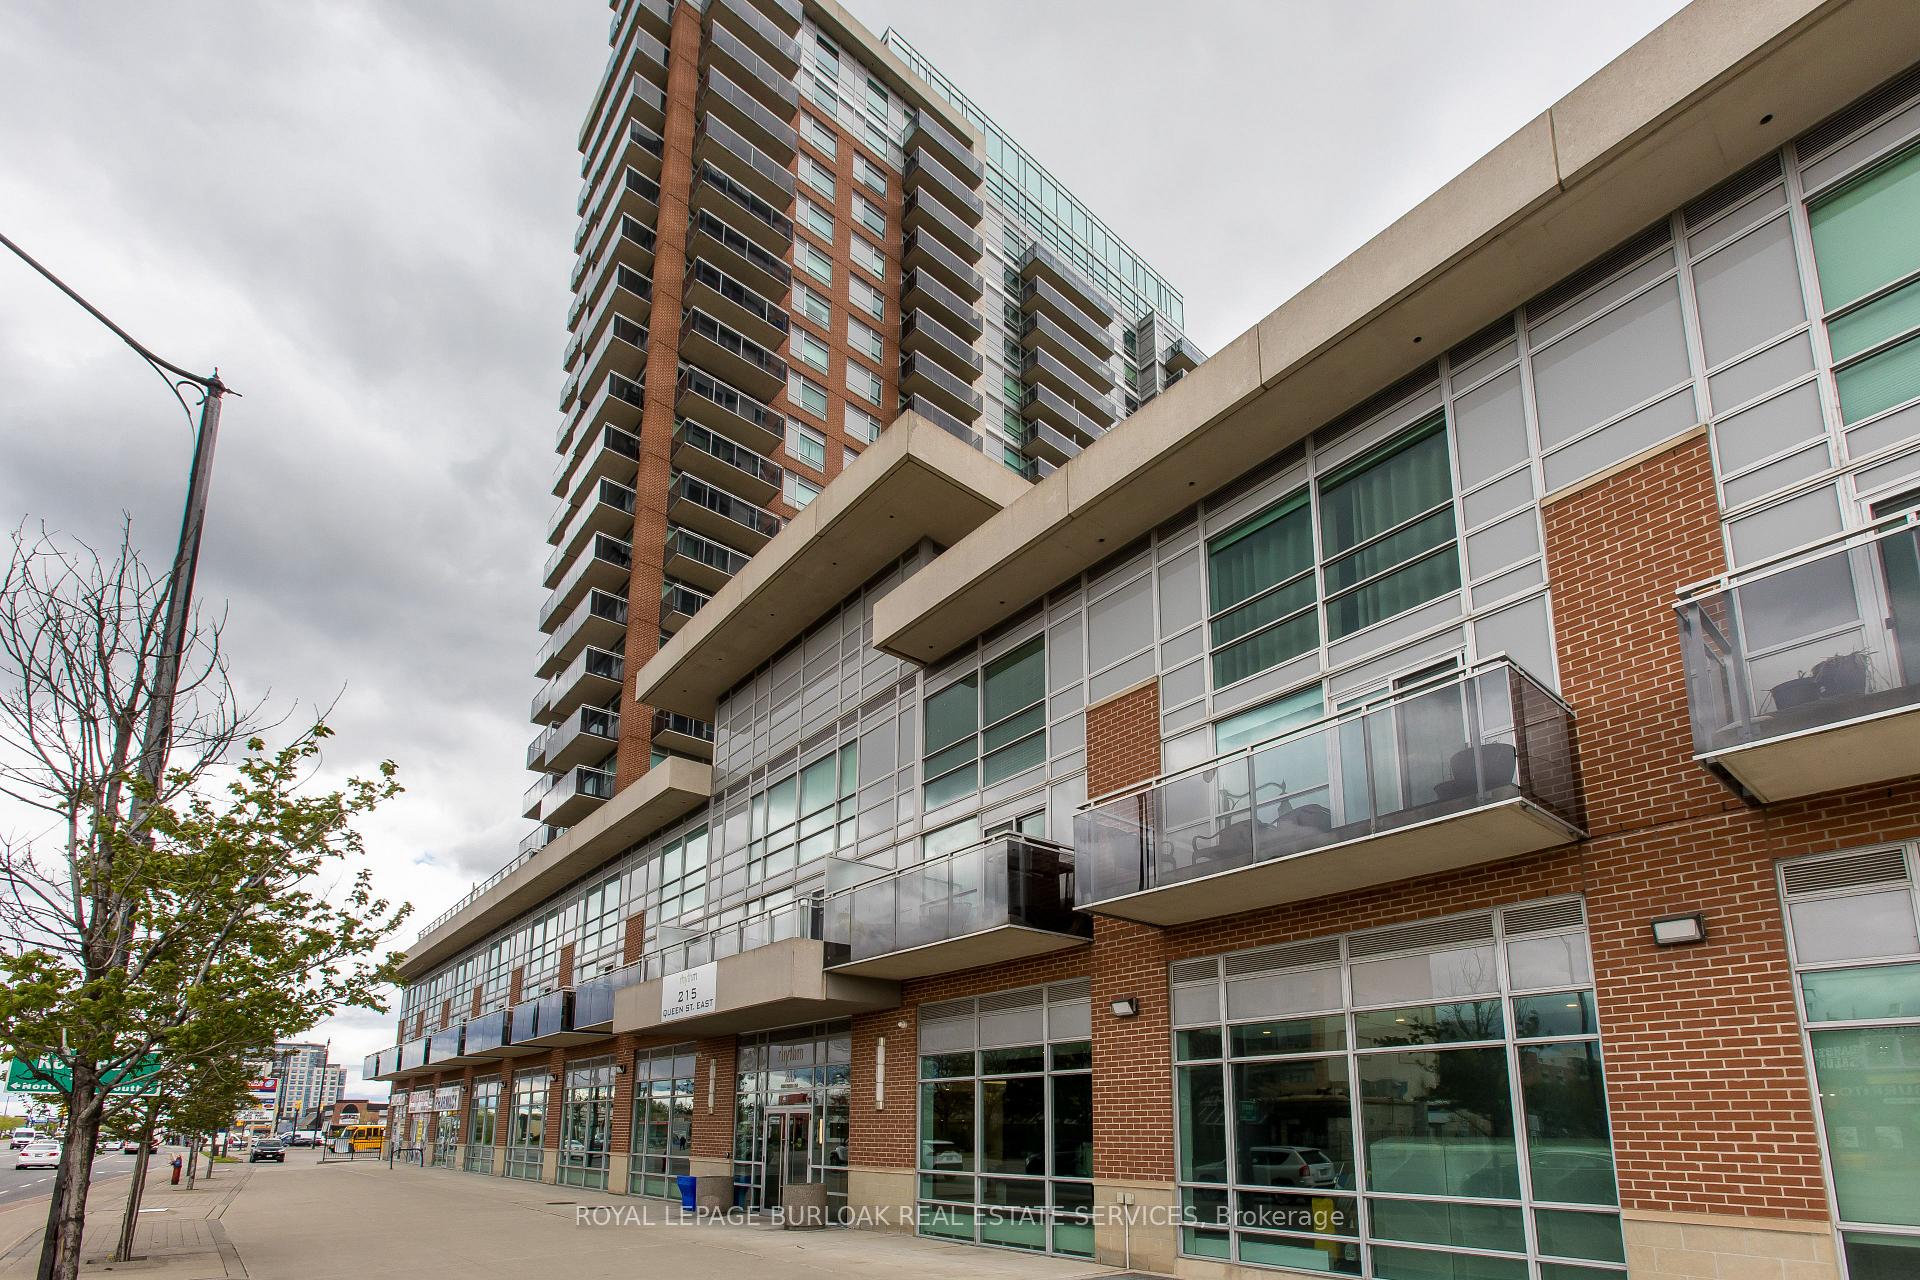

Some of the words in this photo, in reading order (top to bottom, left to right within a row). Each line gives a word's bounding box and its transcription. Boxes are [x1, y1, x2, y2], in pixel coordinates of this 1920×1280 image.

[678, 987, 697, 1003] 215
[663, 1005, 684, 1018] QUEEN
[686, 1003, 695, 1012] ST.
[697, 999, 714, 1010] EAST
